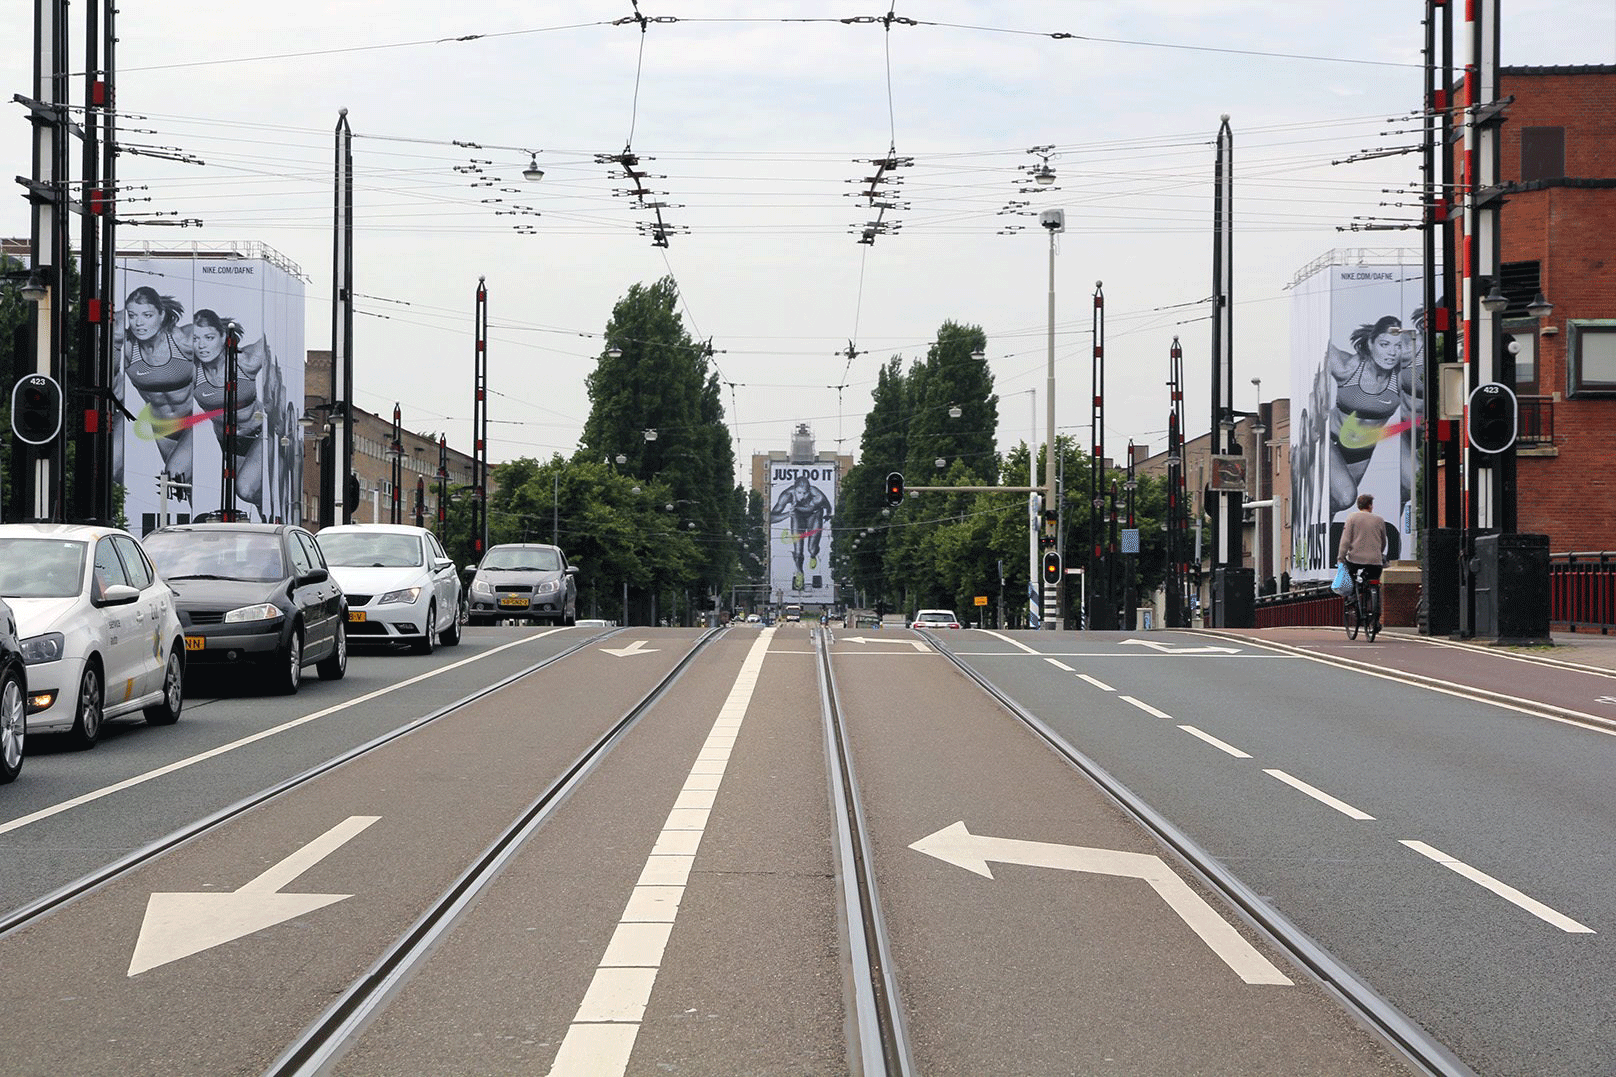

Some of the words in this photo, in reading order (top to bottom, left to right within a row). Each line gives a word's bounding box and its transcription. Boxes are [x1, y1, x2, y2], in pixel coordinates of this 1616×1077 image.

[202, 266, 254, 274] NIKE.COM/DAFNE
[1340, 272, 1393, 280] NIKE.COM/DAFNE
[1483, 386, 1499, 394] 423
[773, 468, 799, 481] JUST
[802, 468, 820, 481] DO
[822, 468, 833, 481] IT
